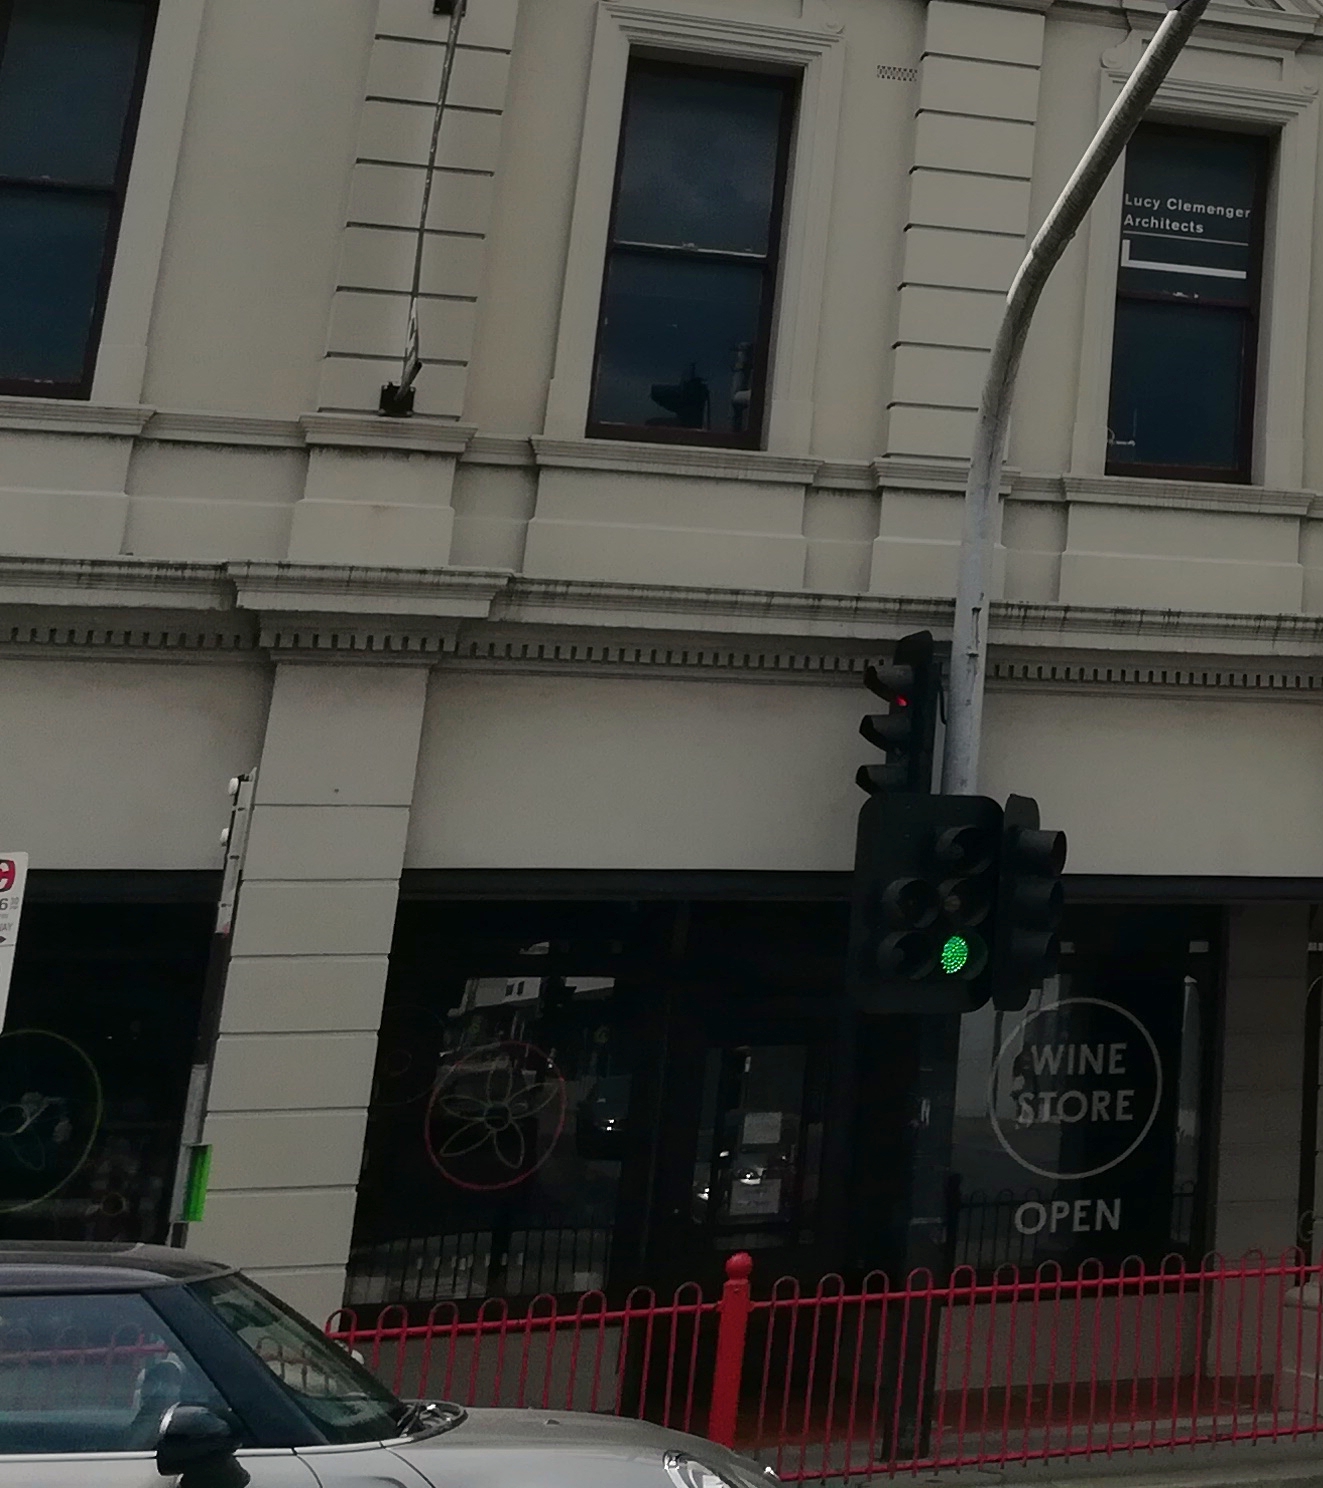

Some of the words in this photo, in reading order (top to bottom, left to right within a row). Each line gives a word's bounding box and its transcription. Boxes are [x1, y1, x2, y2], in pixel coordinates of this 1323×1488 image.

[1124, 193, 1160, 211] Lucy
[1166, 198, 1251, 219] Clemenger
[1123, 214, 1204, 233] Architects
[1031, 1042, 1128, 1076] WINE
[1017, 1089, 1136, 1124] STORE
[1014, 1198, 1121, 1235] OPEN
